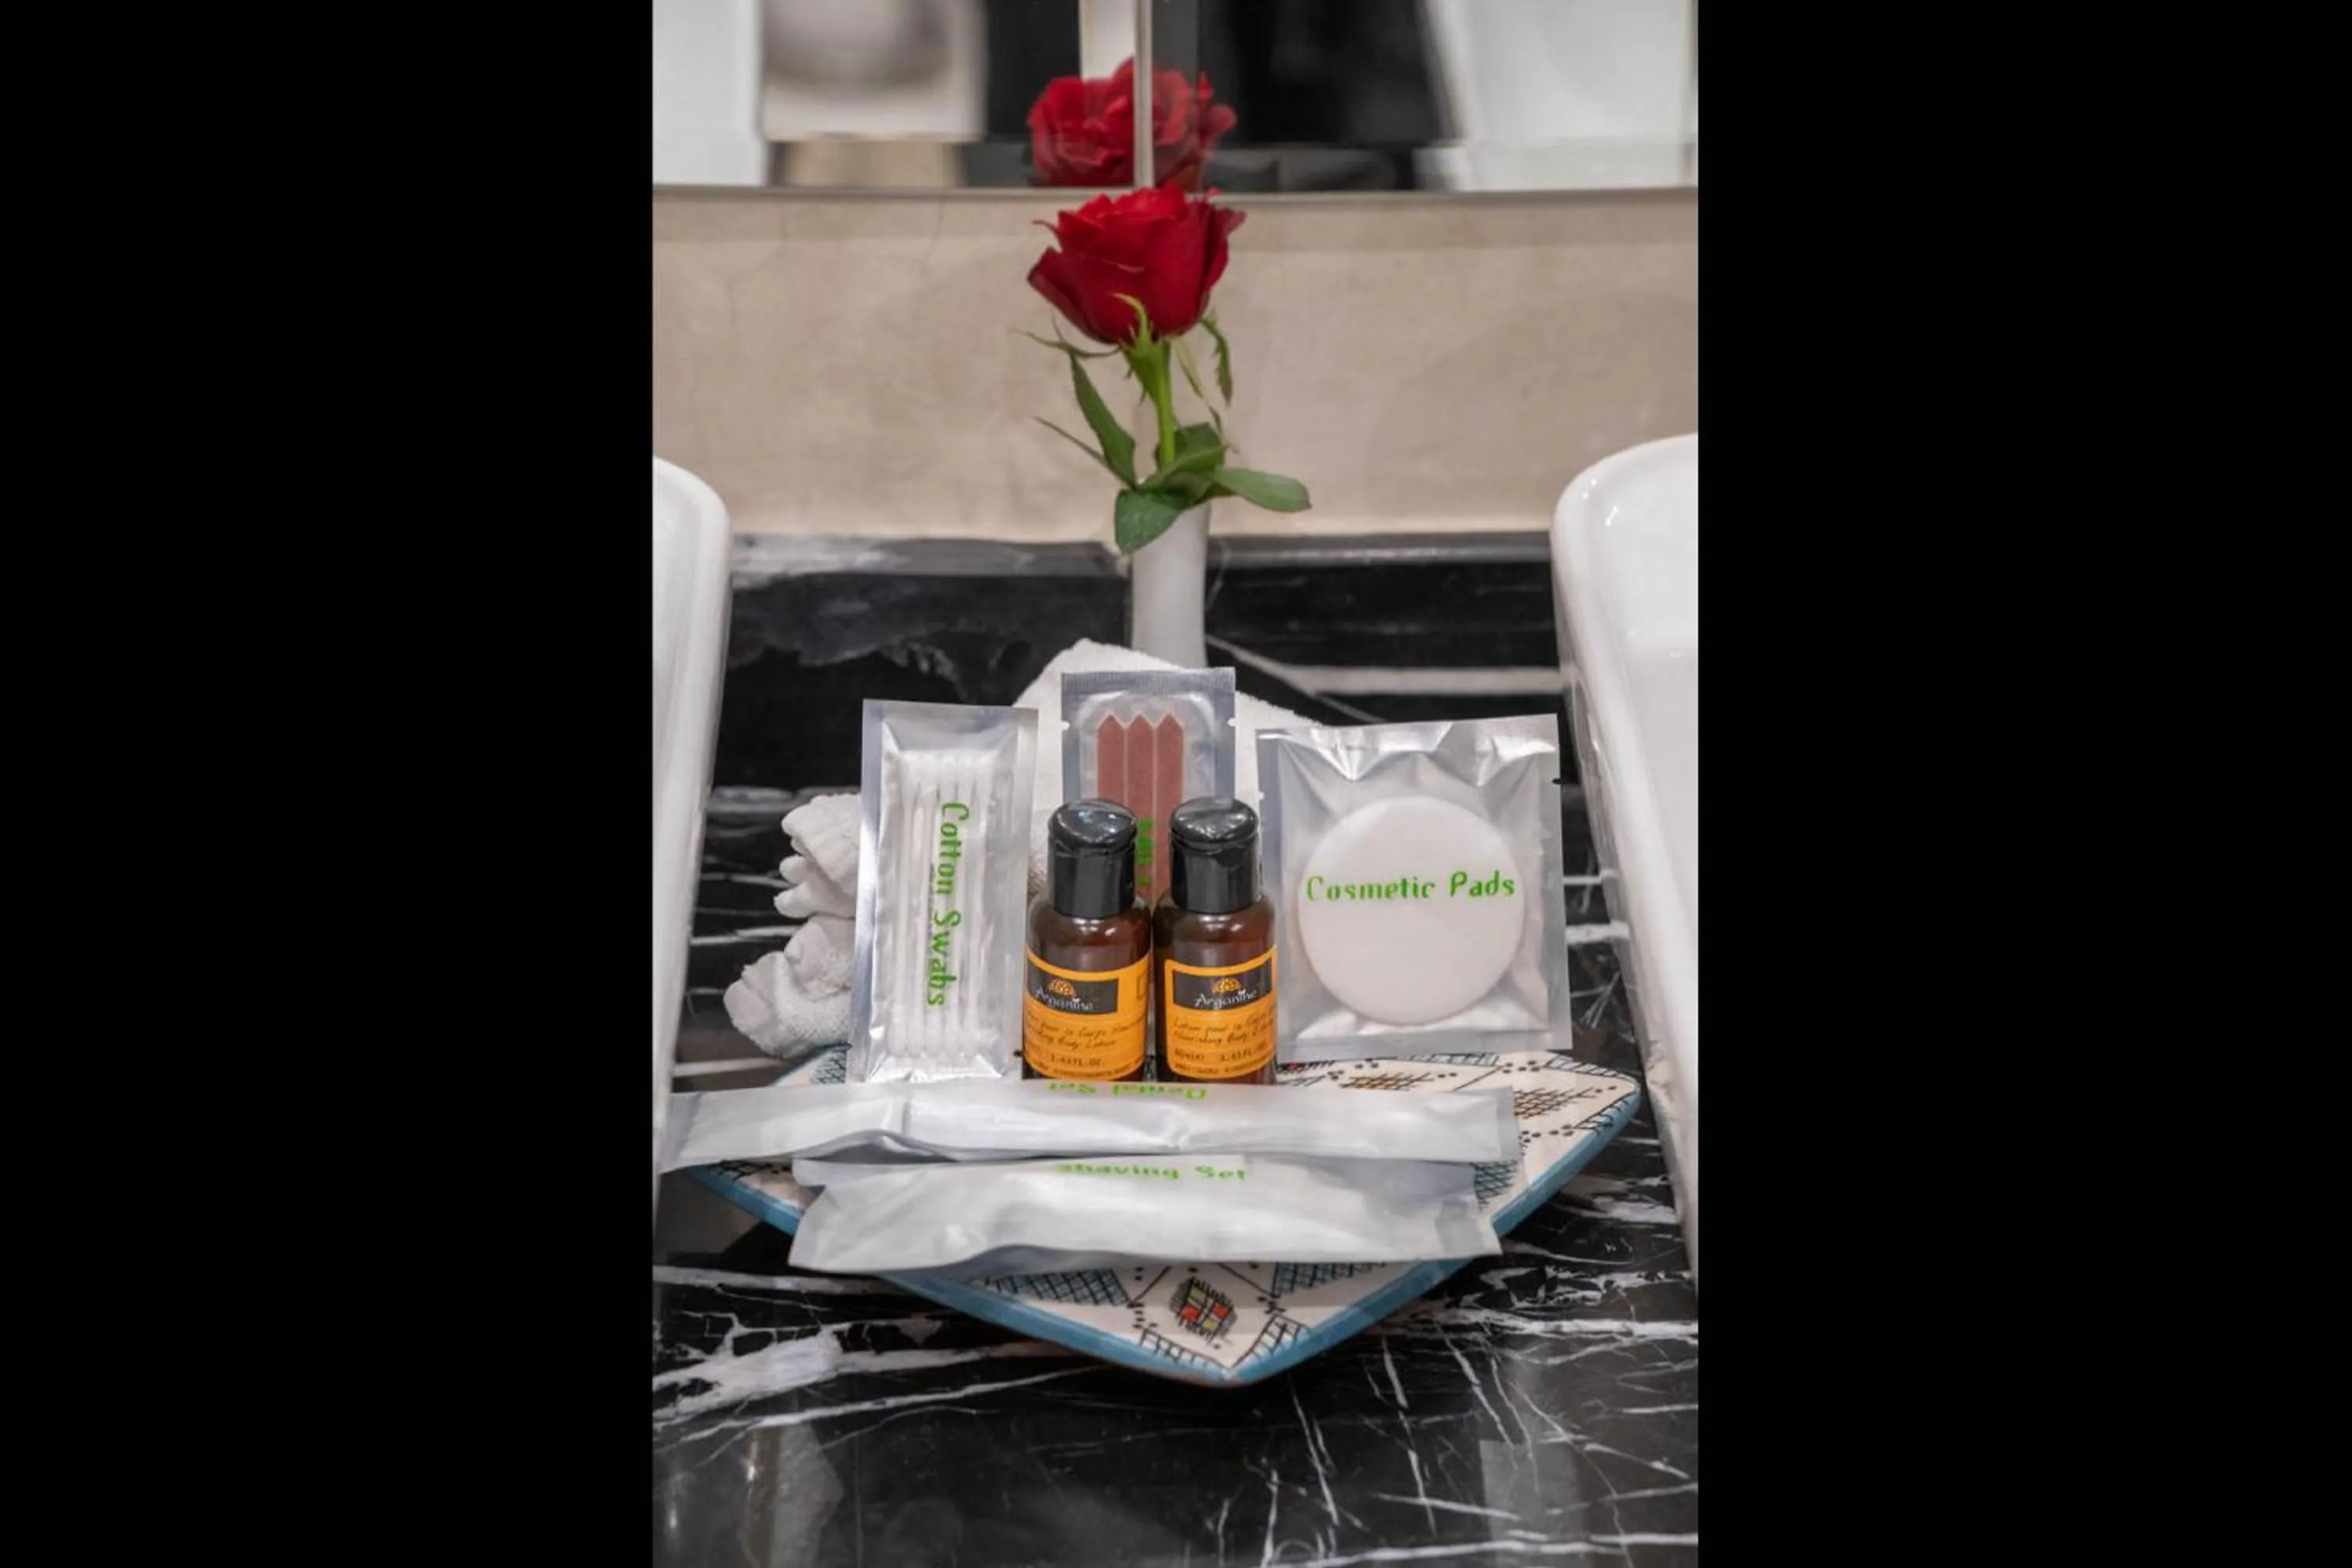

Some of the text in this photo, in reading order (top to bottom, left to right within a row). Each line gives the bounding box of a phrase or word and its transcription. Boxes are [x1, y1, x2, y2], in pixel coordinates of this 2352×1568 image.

[1306, 869, 1515, 901] Cosmetic Pads
[927, 802, 970, 1006] Cotton Swabs
[1194, 1165, 1245, 1180] Set
